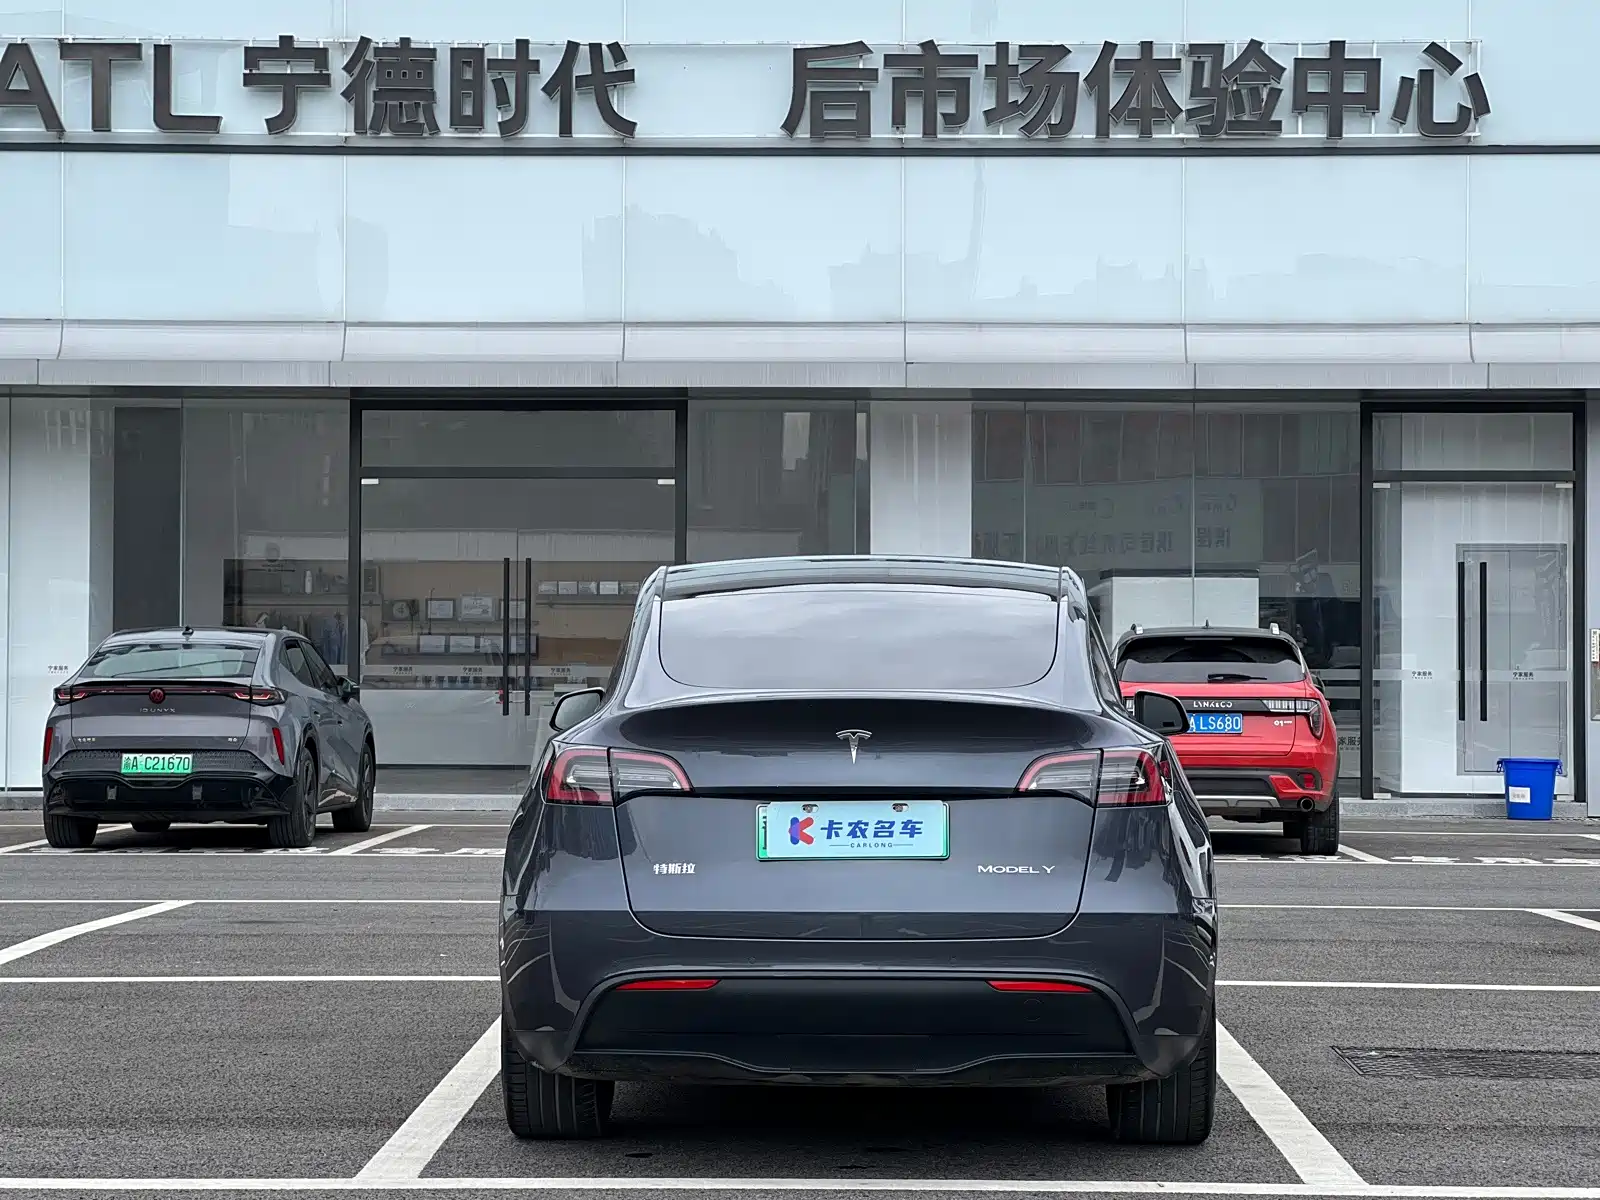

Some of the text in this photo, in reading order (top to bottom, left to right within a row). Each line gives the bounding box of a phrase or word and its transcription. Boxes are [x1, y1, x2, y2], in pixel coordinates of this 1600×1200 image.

[0, 35, 1491, 140] ATL 宁德时代 后市场体验中心
[820, 819, 923, 839] 卡农名车
[653, 863, 696, 875] 特斯拉
[977, 865, 1056, 874] MODEL Y
